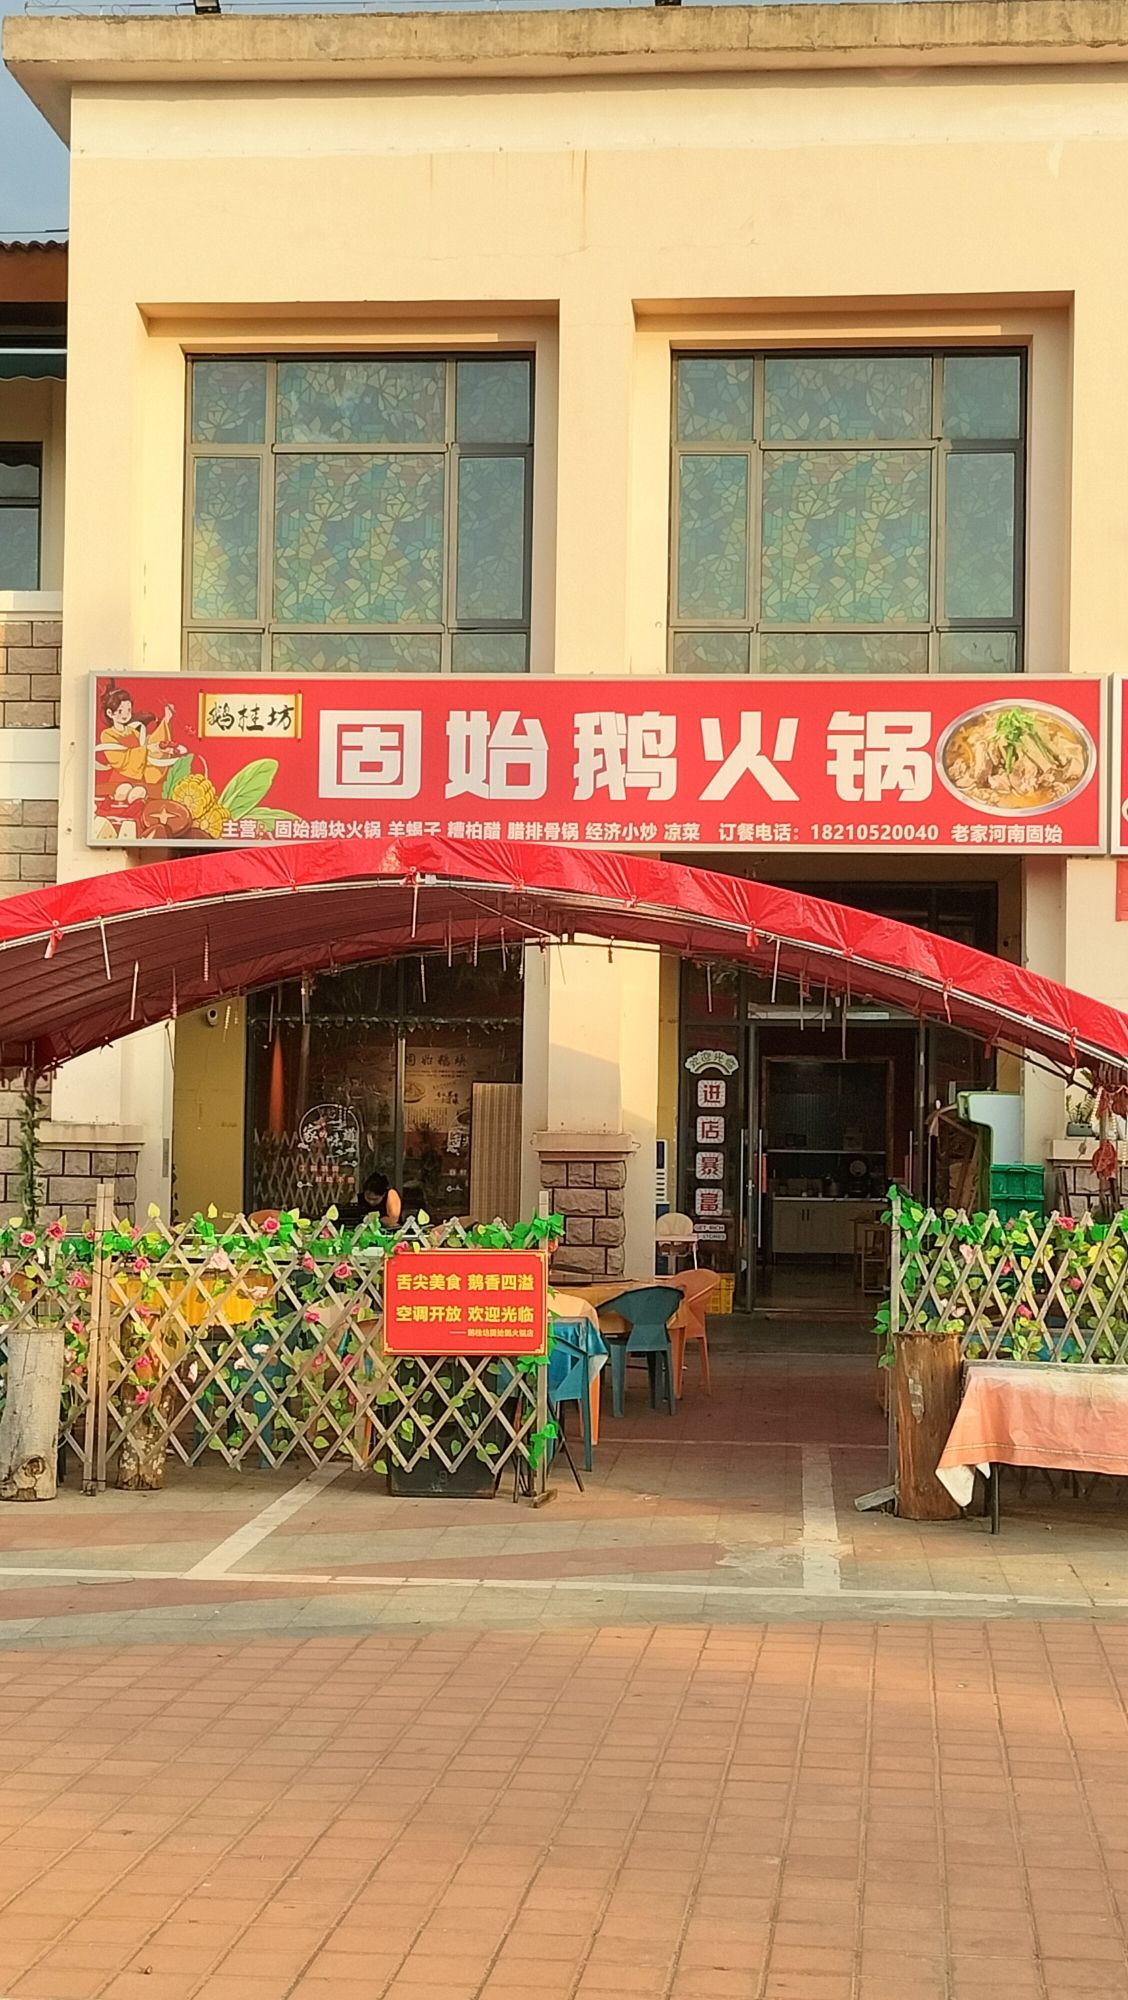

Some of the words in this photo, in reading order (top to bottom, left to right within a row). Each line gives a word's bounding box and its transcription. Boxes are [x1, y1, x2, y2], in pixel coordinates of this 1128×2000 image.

[207, 702, 294, 732] 鹅桂坊
[318, 710, 932, 802] 固始鹅火锅
[275, 820, 381, 840] 固始鹅块火锅
[388, 821, 441, 837] 羊蝎子
[507, 821, 579, 841] 腊排骨锅
[585, 822, 658, 841] 经济小炒
[664, 823, 700, 841] 凉菜
[718, 823, 800, 842] 订餐电话：
[810, 824, 939, 841] 18210520040
[951, 823, 1063, 844] 老家河南固始
[396, 1274, 461, 1291] 舌尖美食
[467, 1274, 534, 1291] 鹅香四溢
[396, 1306, 461, 1322] 空调开放
[467, 1306, 534, 1322] 欢迎光临
